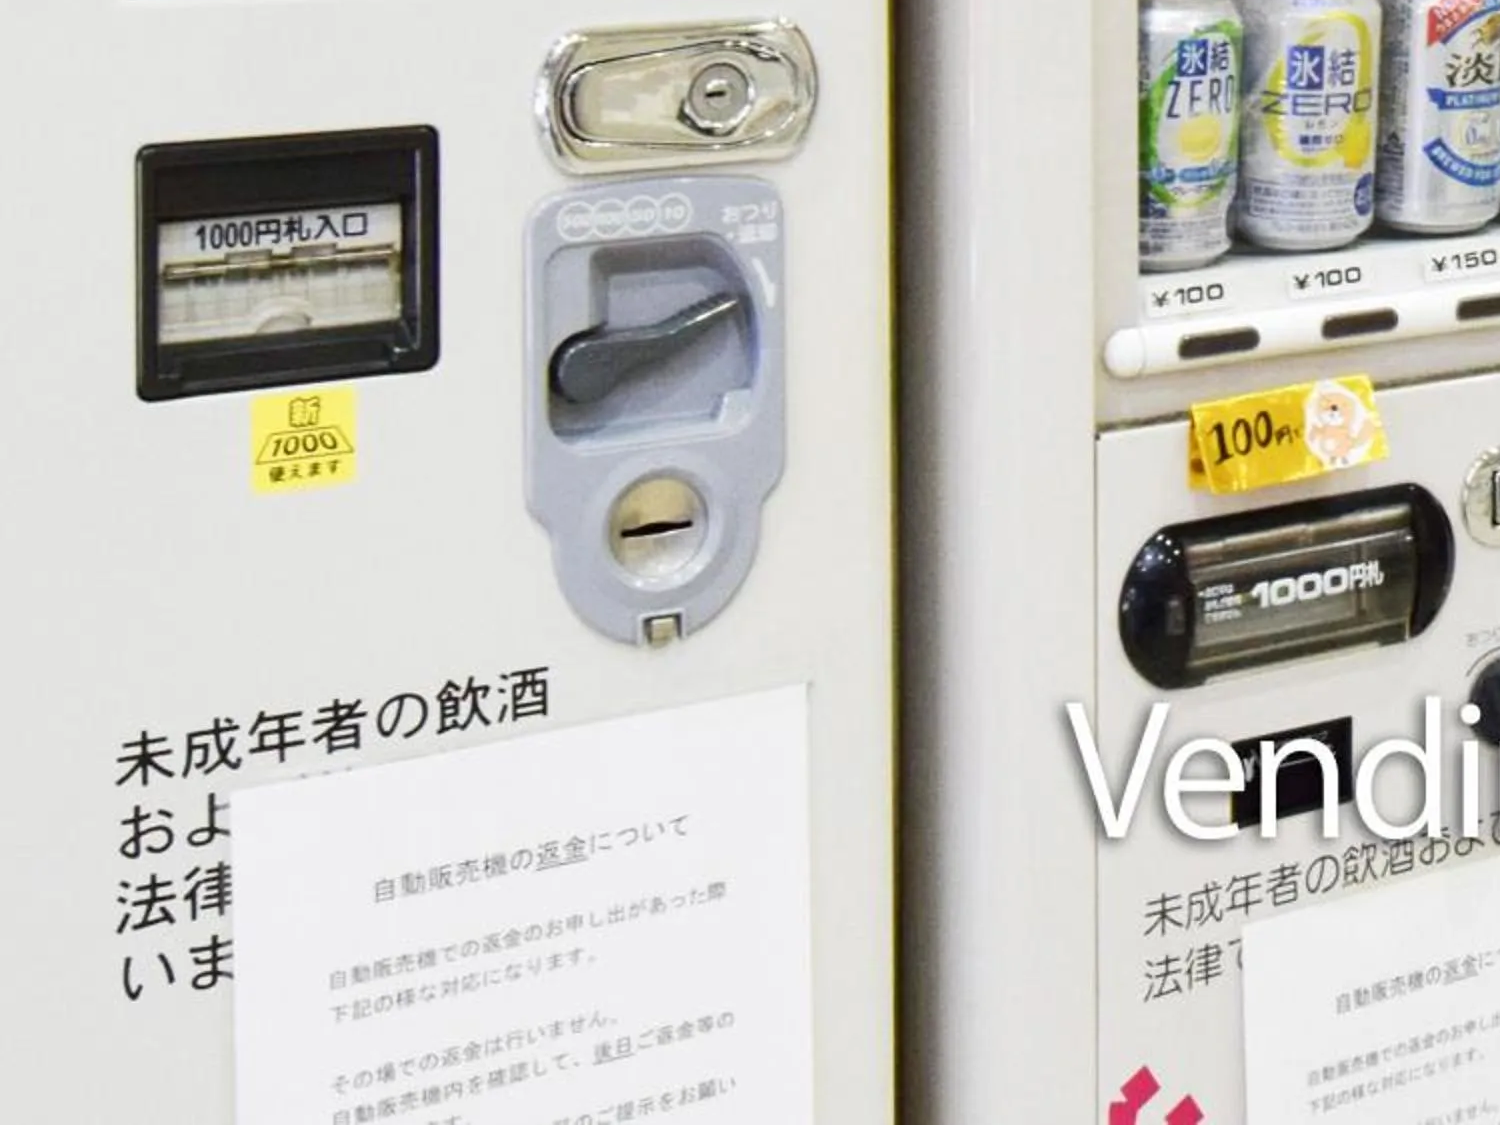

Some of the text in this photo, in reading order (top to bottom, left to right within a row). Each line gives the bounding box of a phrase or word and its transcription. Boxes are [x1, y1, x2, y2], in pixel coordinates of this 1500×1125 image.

[1177, 39, 1231, 77] 氷結
[1287, 46, 1357, 90] 氷結
[1166, 74, 1235, 119] ZERO
[1261, 89, 1373, 117] ZERO
[195, 212, 368, 251] 1000円札入口
[1293, 265, 1363, 291] ¥100
[1431, 248, 1499, 274] ¥150
[1151, 282, 1225, 309] ¥100
[271, 431, 338, 487] 1000
[1251, 560, 1385, 609] 1000円札
[115, 666, 552, 788] 未成年者の飲酒
[372, 814, 692, 905] 自動販売機の返金について
